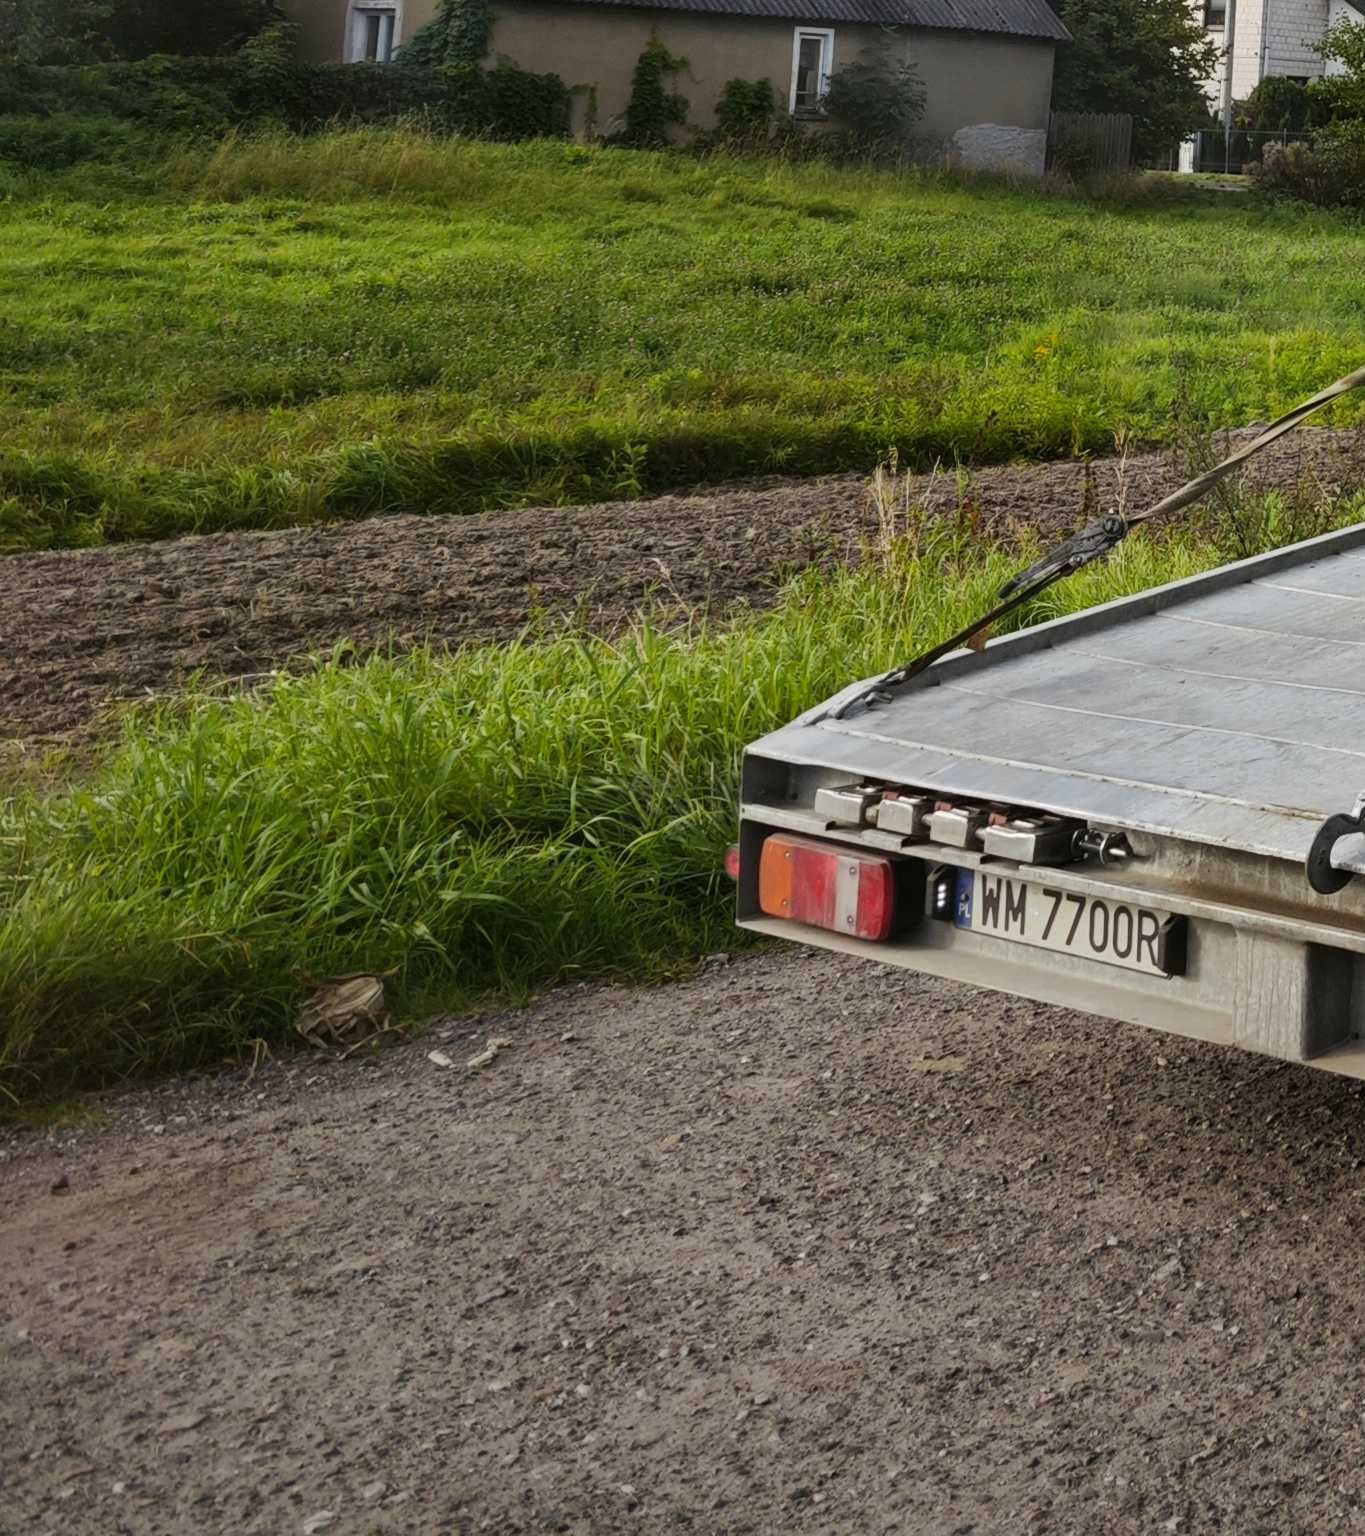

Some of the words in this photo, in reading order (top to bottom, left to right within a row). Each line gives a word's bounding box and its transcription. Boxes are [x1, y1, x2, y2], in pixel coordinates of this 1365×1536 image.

[958, 902, 971, 919] PL
[981, 873, 1028, 936] WM
[1041, 887, 1160, 967] 7700R
